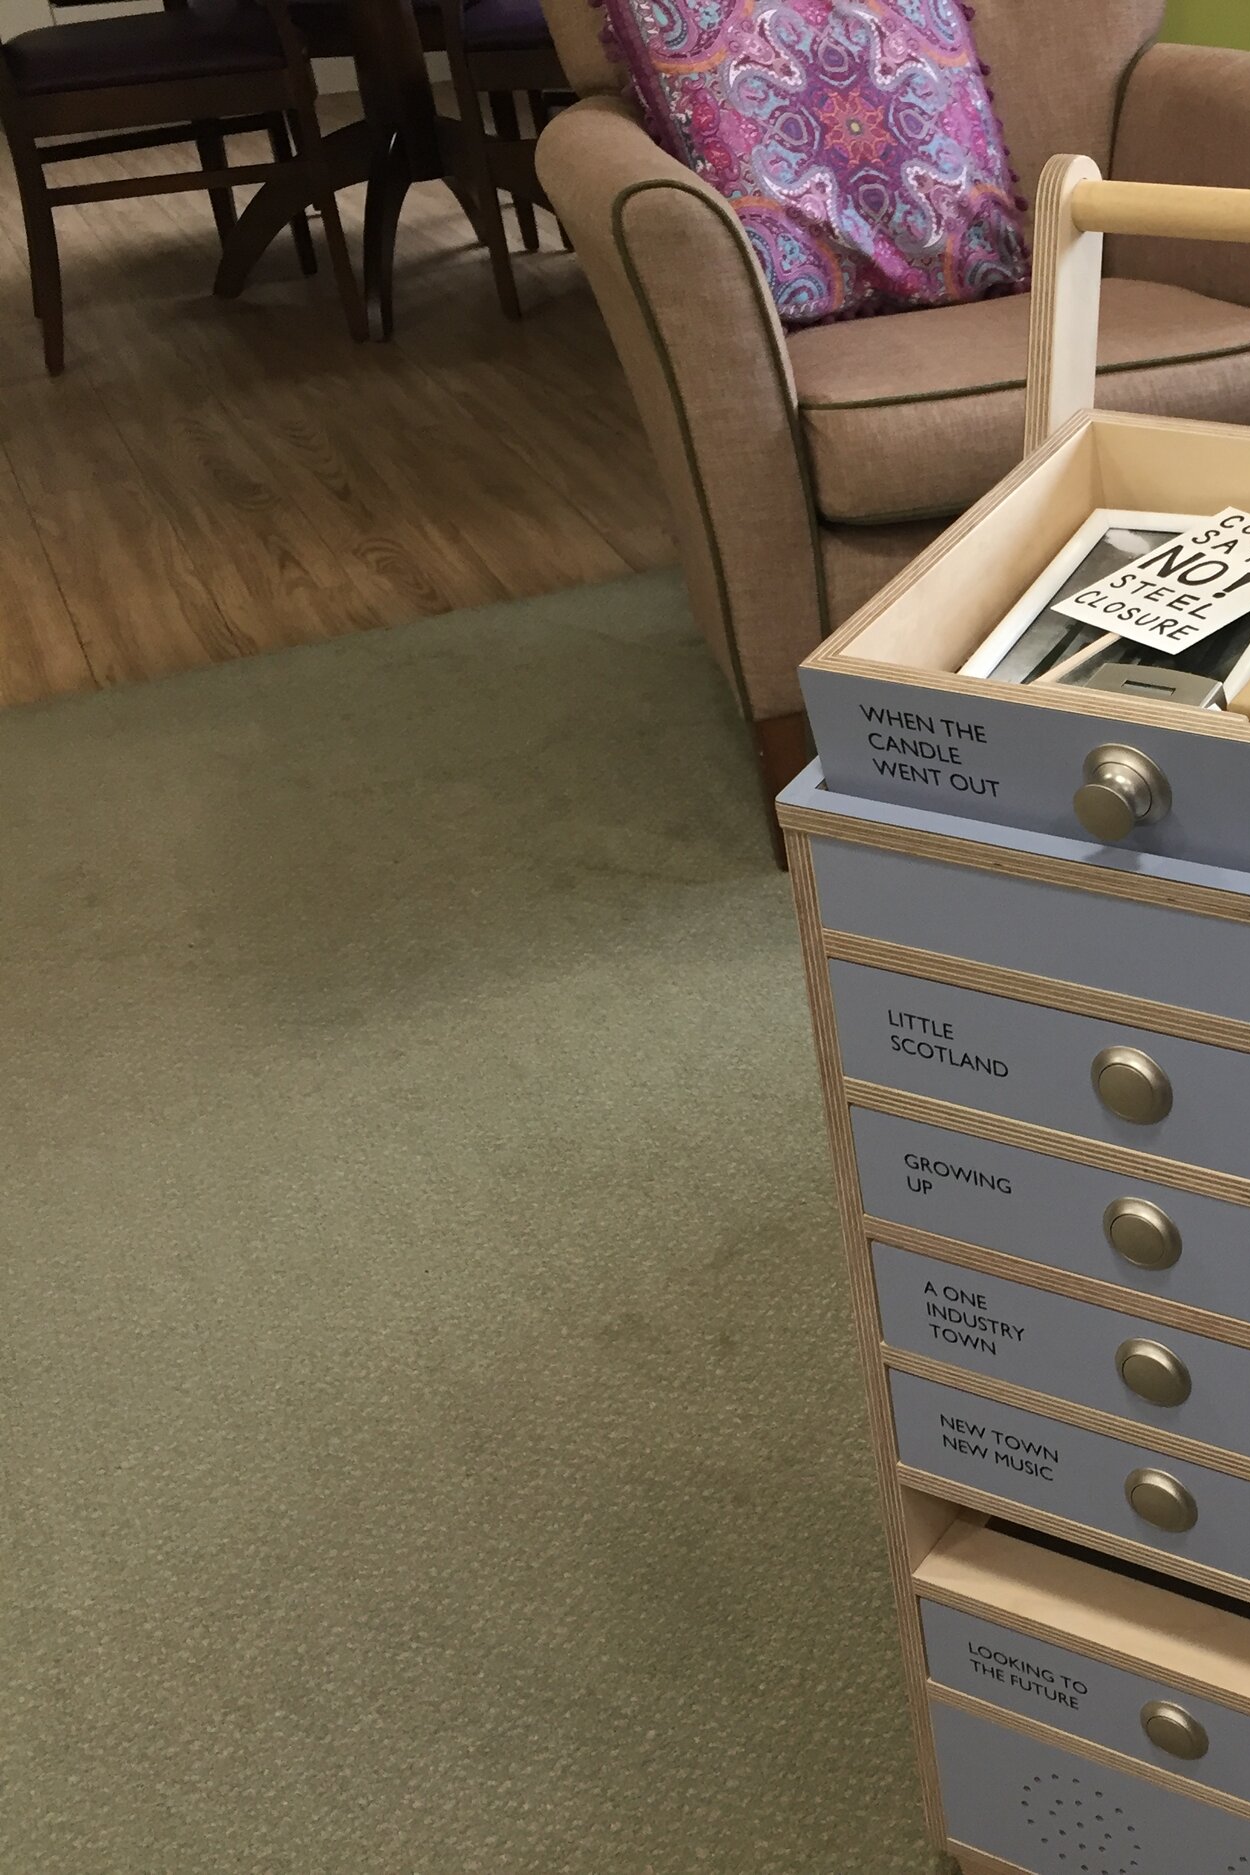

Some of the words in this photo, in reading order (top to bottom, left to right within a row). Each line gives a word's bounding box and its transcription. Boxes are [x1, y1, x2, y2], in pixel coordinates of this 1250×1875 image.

[1073, 590, 1200, 641] CLOSURE
[1109, 573, 1217, 620] STEEL
[859, 704, 935, 734] WHEN
[940, 719, 988, 744] THE
[868, 732, 962, 765] CANDLE
[872, 758, 941, 786] WENT
[950, 773, 1000, 797] OUT
[888, 1009, 954, 1040] LITTLE
[890, 1035, 1009, 1078] SCOTLAND
[904, 1153, 1012, 1194] GROWING
[907, 1176, 933, 1195] UP
[924, 1281, 938, 1297] A
[943, 1286, 987, 1310] ONE
[926, 1302, 1025, 1341] INDUSTRY
[929, 1323, 996, 1355] TOWN
[940, 1414, 986, 1438] NEW
[991, 1430, 1059, 1463] TOWN
[942, 1434, 988, 1459] NEW
[995, 1451, 1054, 1481] MUSIC
[968, 1641, 1055, 1683] LOOKING
[1060, 1675, 1088, 1695] TO
[969, 1659, 1005, 1683] THE
[1010, 1674, 1079, 1710] FUTURE
